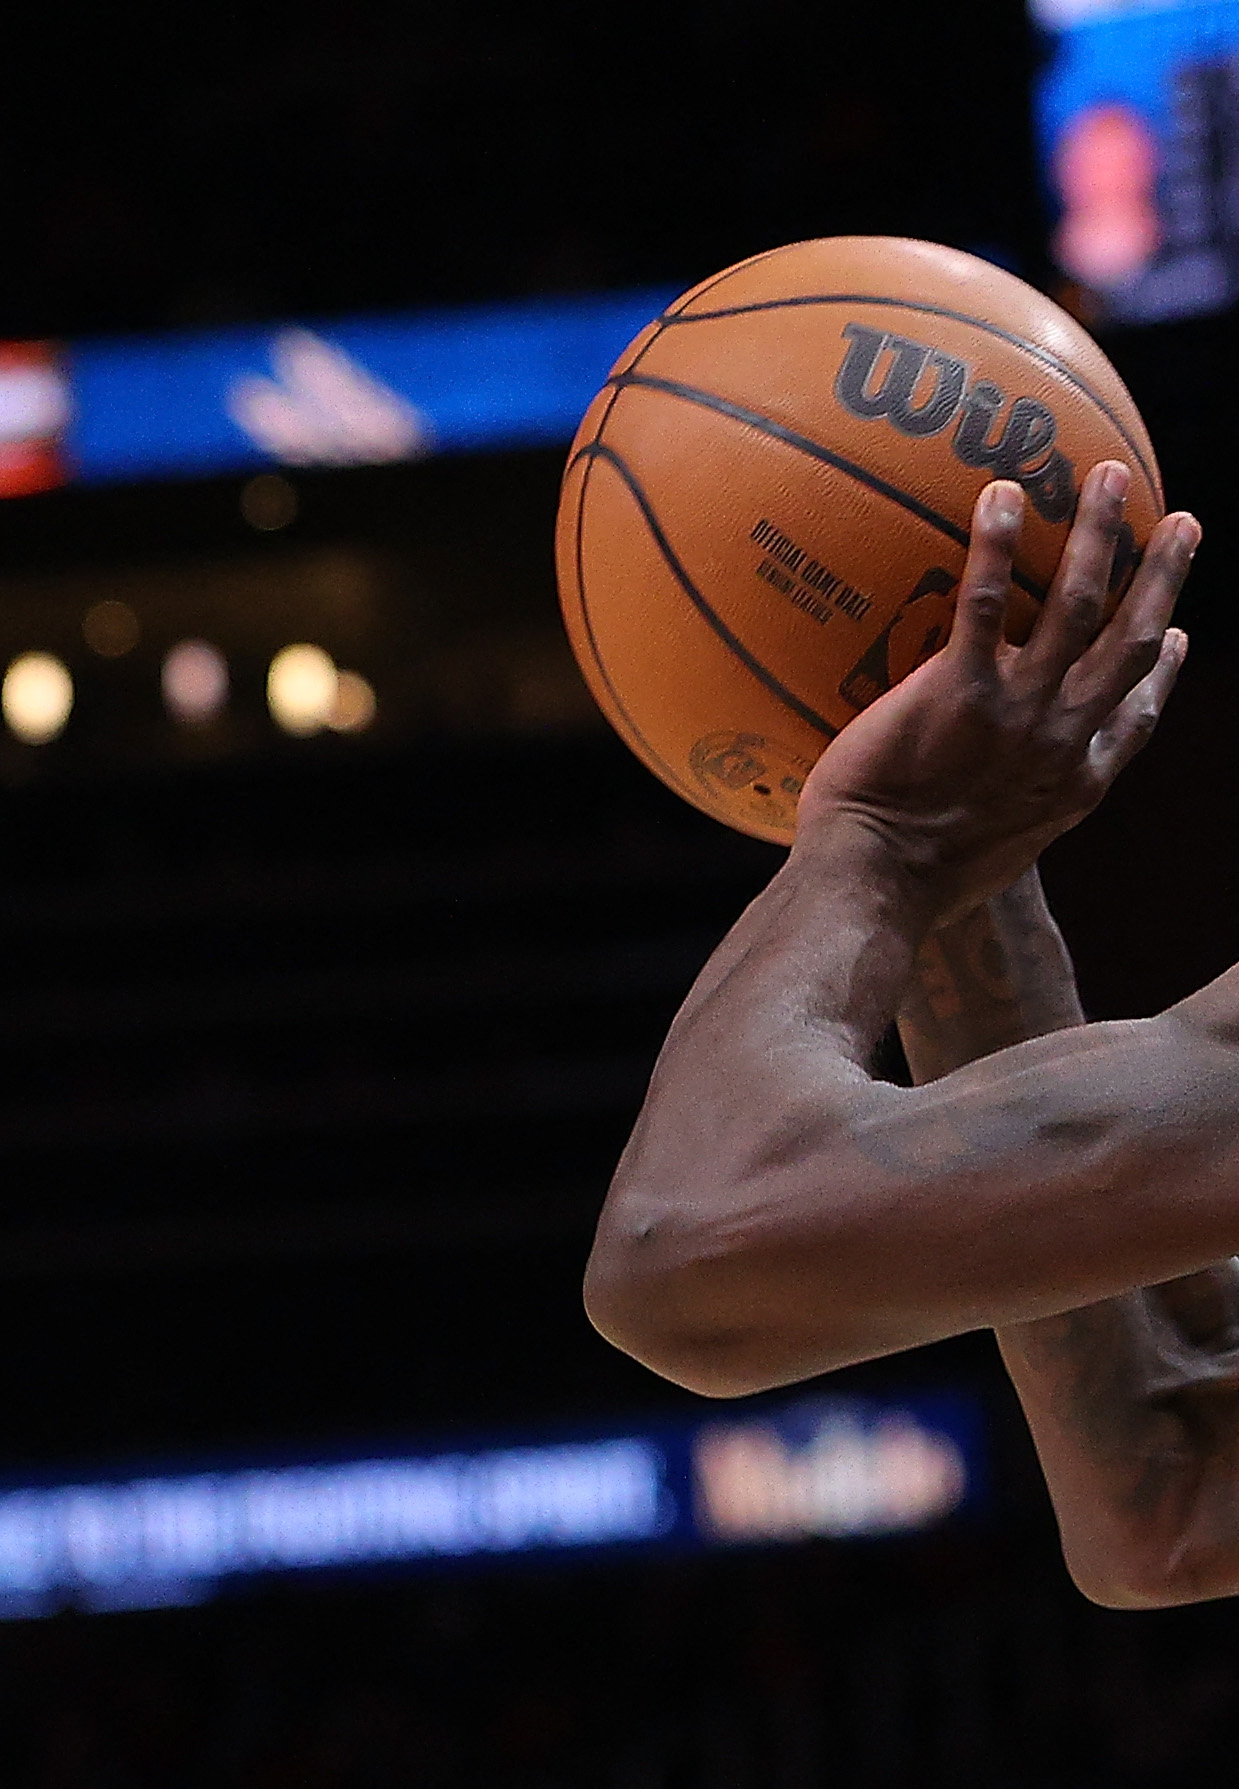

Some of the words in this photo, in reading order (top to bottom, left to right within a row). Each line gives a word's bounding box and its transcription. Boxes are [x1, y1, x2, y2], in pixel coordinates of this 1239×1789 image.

[750, 519, 808, 573] OFFICIAL
[801, 559, 842, 601] GAME
[834, 585, 872, 621] BALL
